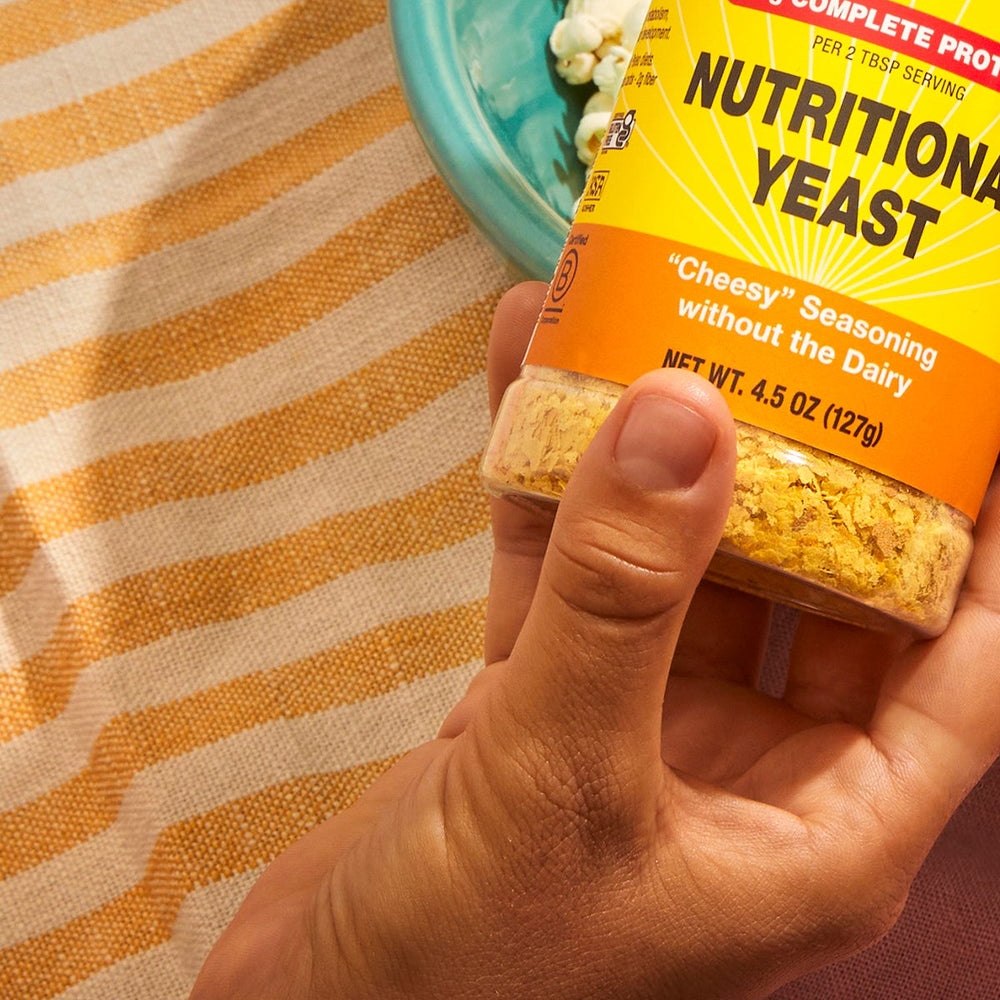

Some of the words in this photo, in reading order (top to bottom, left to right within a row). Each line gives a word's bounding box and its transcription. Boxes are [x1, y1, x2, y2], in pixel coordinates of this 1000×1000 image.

[812, 35, 843, 56] PER
[845, 46, 856, 61] 2
[861, 49, 900, 74] TBSP
[902, 65, 967, 101] SERVING
[752, 147, 941, 260] YEAST
[677, 298, 784, 347] without
[789, 330, 836, 365] the
[841, 348, 912, 398] Dairy
[799, 295, 939, 371] Seasoning
[708, 362, 745, 396] WT.
[751, 378, 787, 409] 4.5
[789, 391, 822, 422] OZ
[823, 403, 883, 448] (127g)
